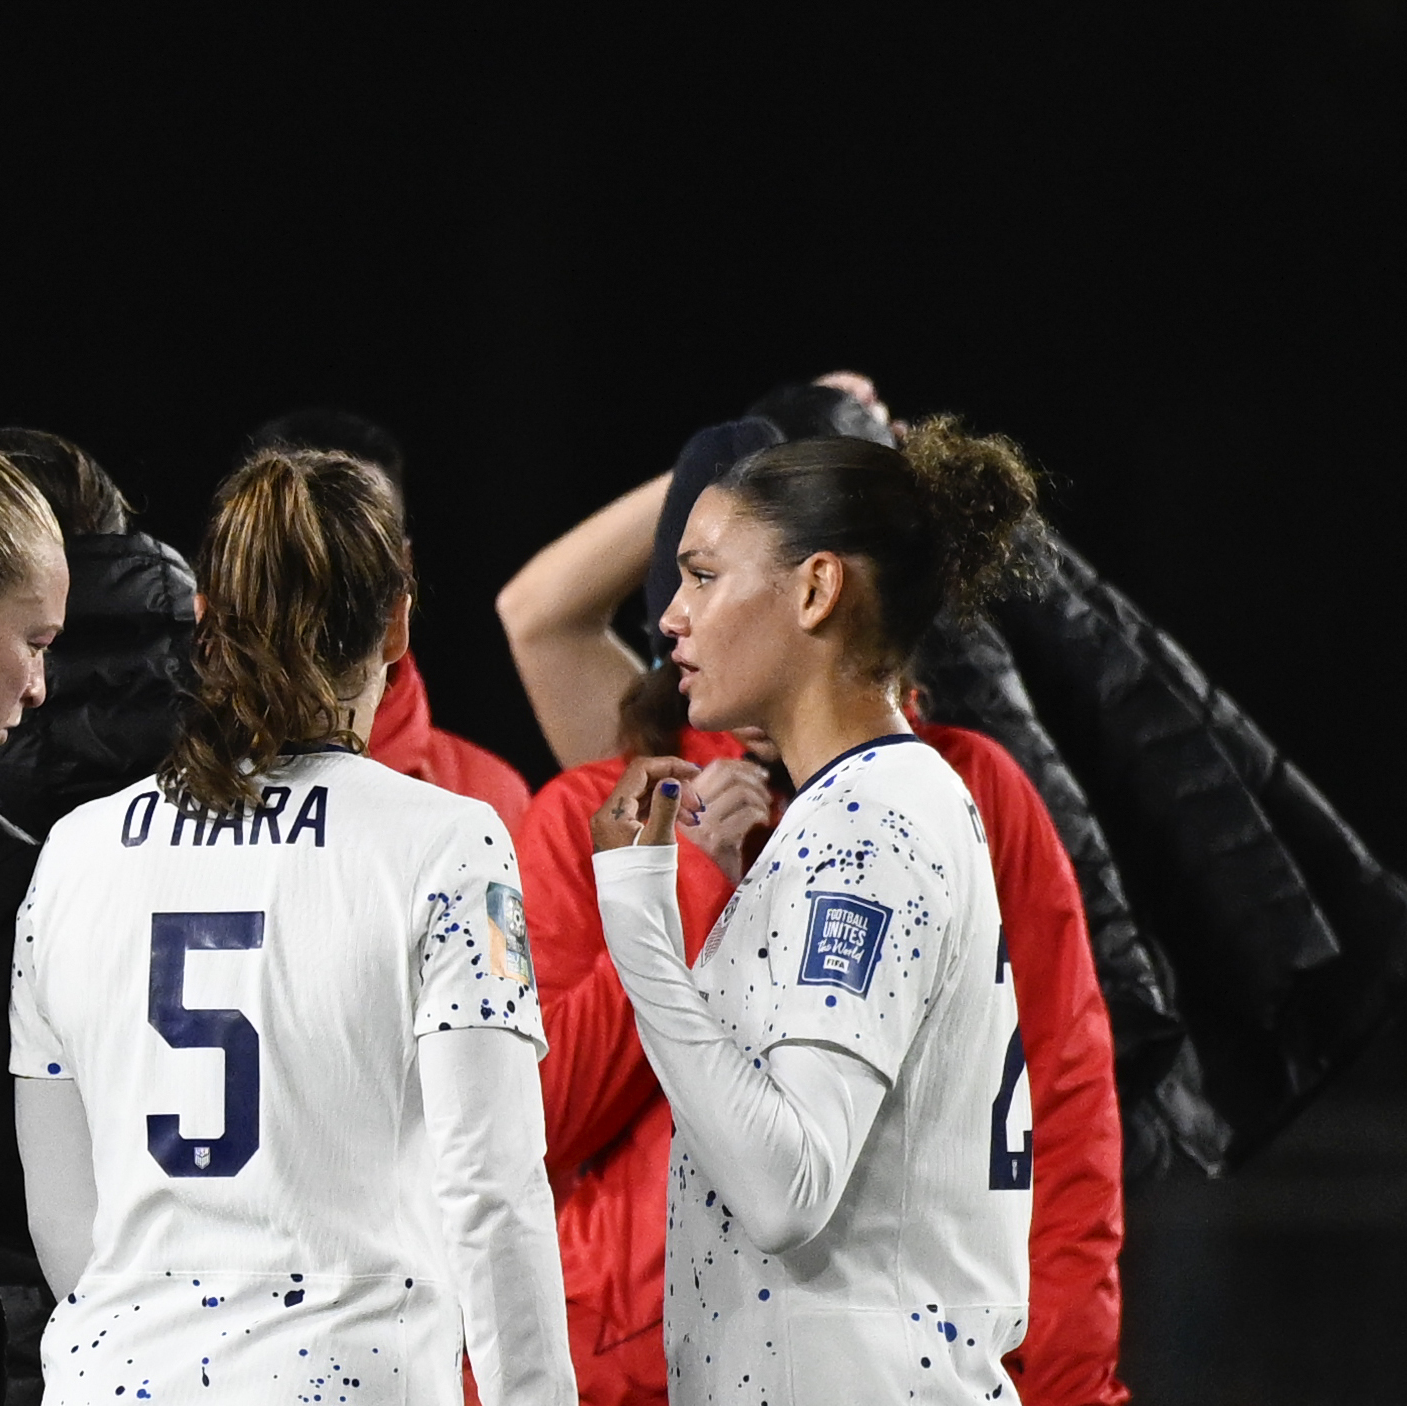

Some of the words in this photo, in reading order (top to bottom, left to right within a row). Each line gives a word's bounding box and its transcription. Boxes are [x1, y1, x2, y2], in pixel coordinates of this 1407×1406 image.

[825, 908, 869, 931] FOOTBALL
[822, 920, 866, 947] UNITES
[818, 938, 832, 953] the
[832, 938, 865, 964] World
[826, 957, 845, 969] FIFA
[146, 911, 265, 1177] 5
